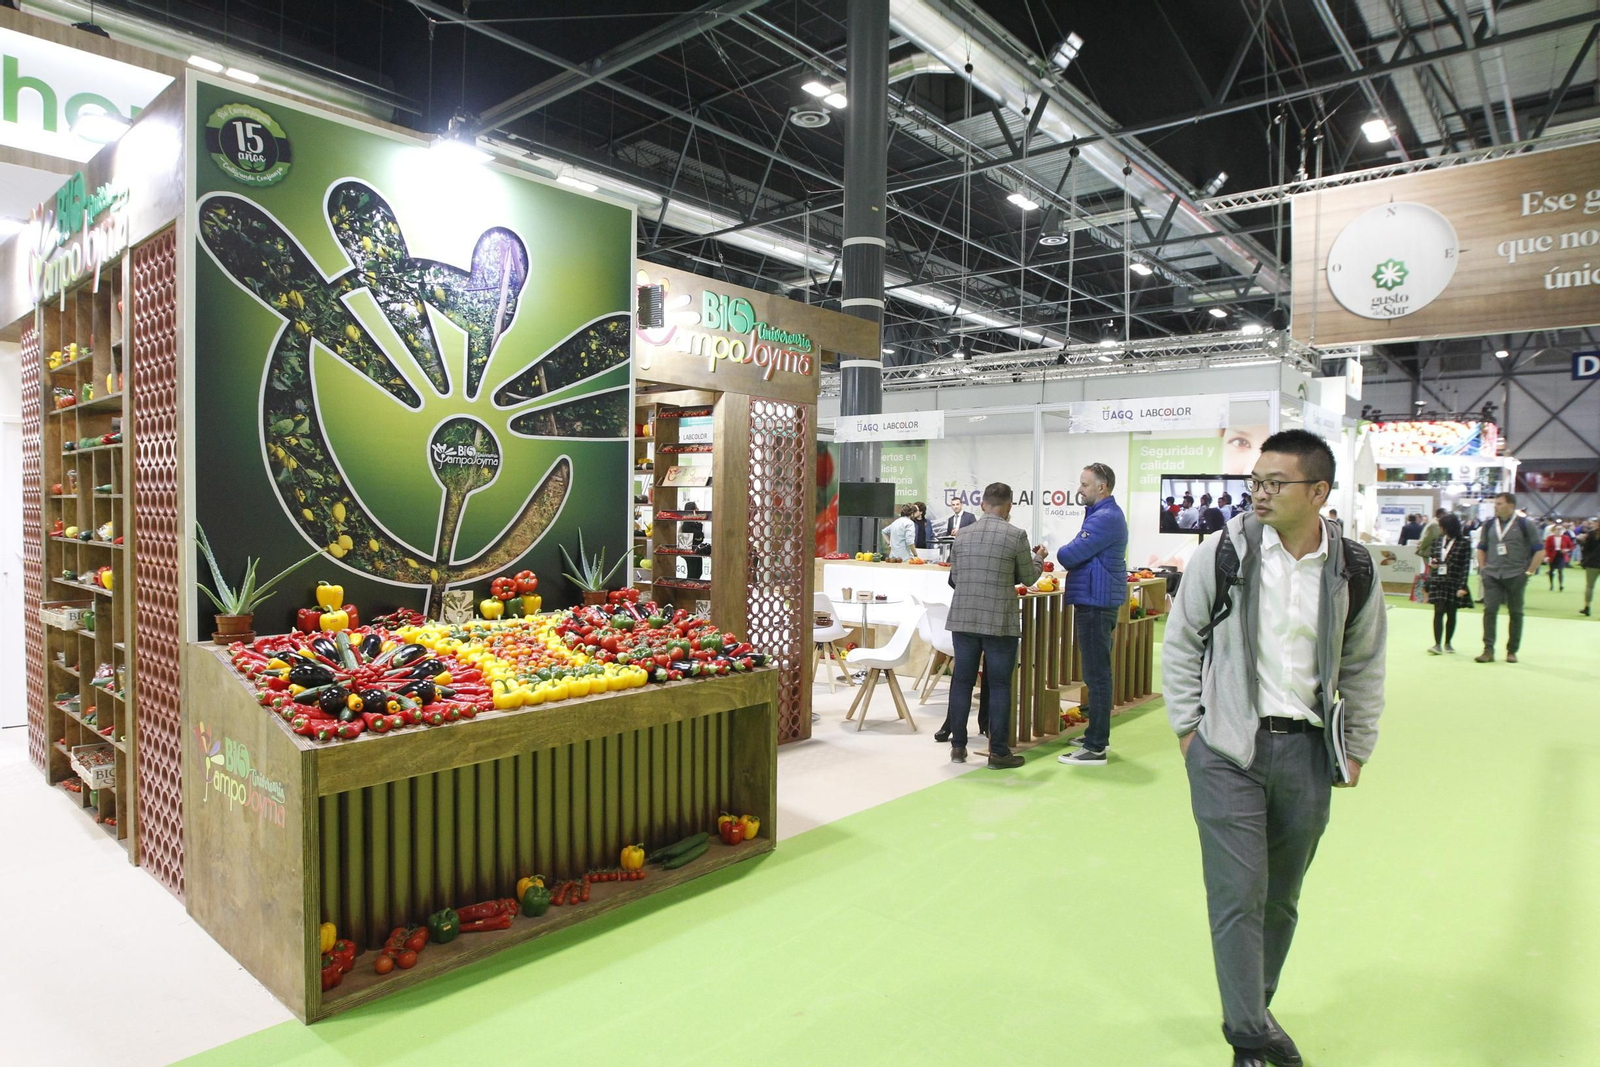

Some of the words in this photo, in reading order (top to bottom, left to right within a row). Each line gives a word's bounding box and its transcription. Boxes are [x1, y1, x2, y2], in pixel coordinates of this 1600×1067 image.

[3, 54, 143, 145] ho
[232, 121, 264, 153] 15
[238, 150, 267, 162] años
[1521, 190, 1577, 216] Ese
[1497, 235, 1553, 264] que
[1560, 229, 1600, 250] no
[1444, 248, 1455, 259] E
[1332, 263, 1342, 273] O
[1371, 293, 1409, 310] gusto
[1383, 305, 1409, 317] Sur
[1578, 355, 1600, 377] D
[1110, 410, 1134, 420] AGQ
[1140, 407, 1192, 418] LABCOLOR
[863, 423, 879, 432] AGQ
[883, 421, 919, 430] LABCOLOR
[683, 433, 708, 441] LABCOLOR
[906, 453, 917, 461] en
[1140, 444, 1204, 458] Seguridad
[1207, 446, 1215, 458] y
[899, 465, 905, 475] y
[1140, 459, 1185, 471] calidad
